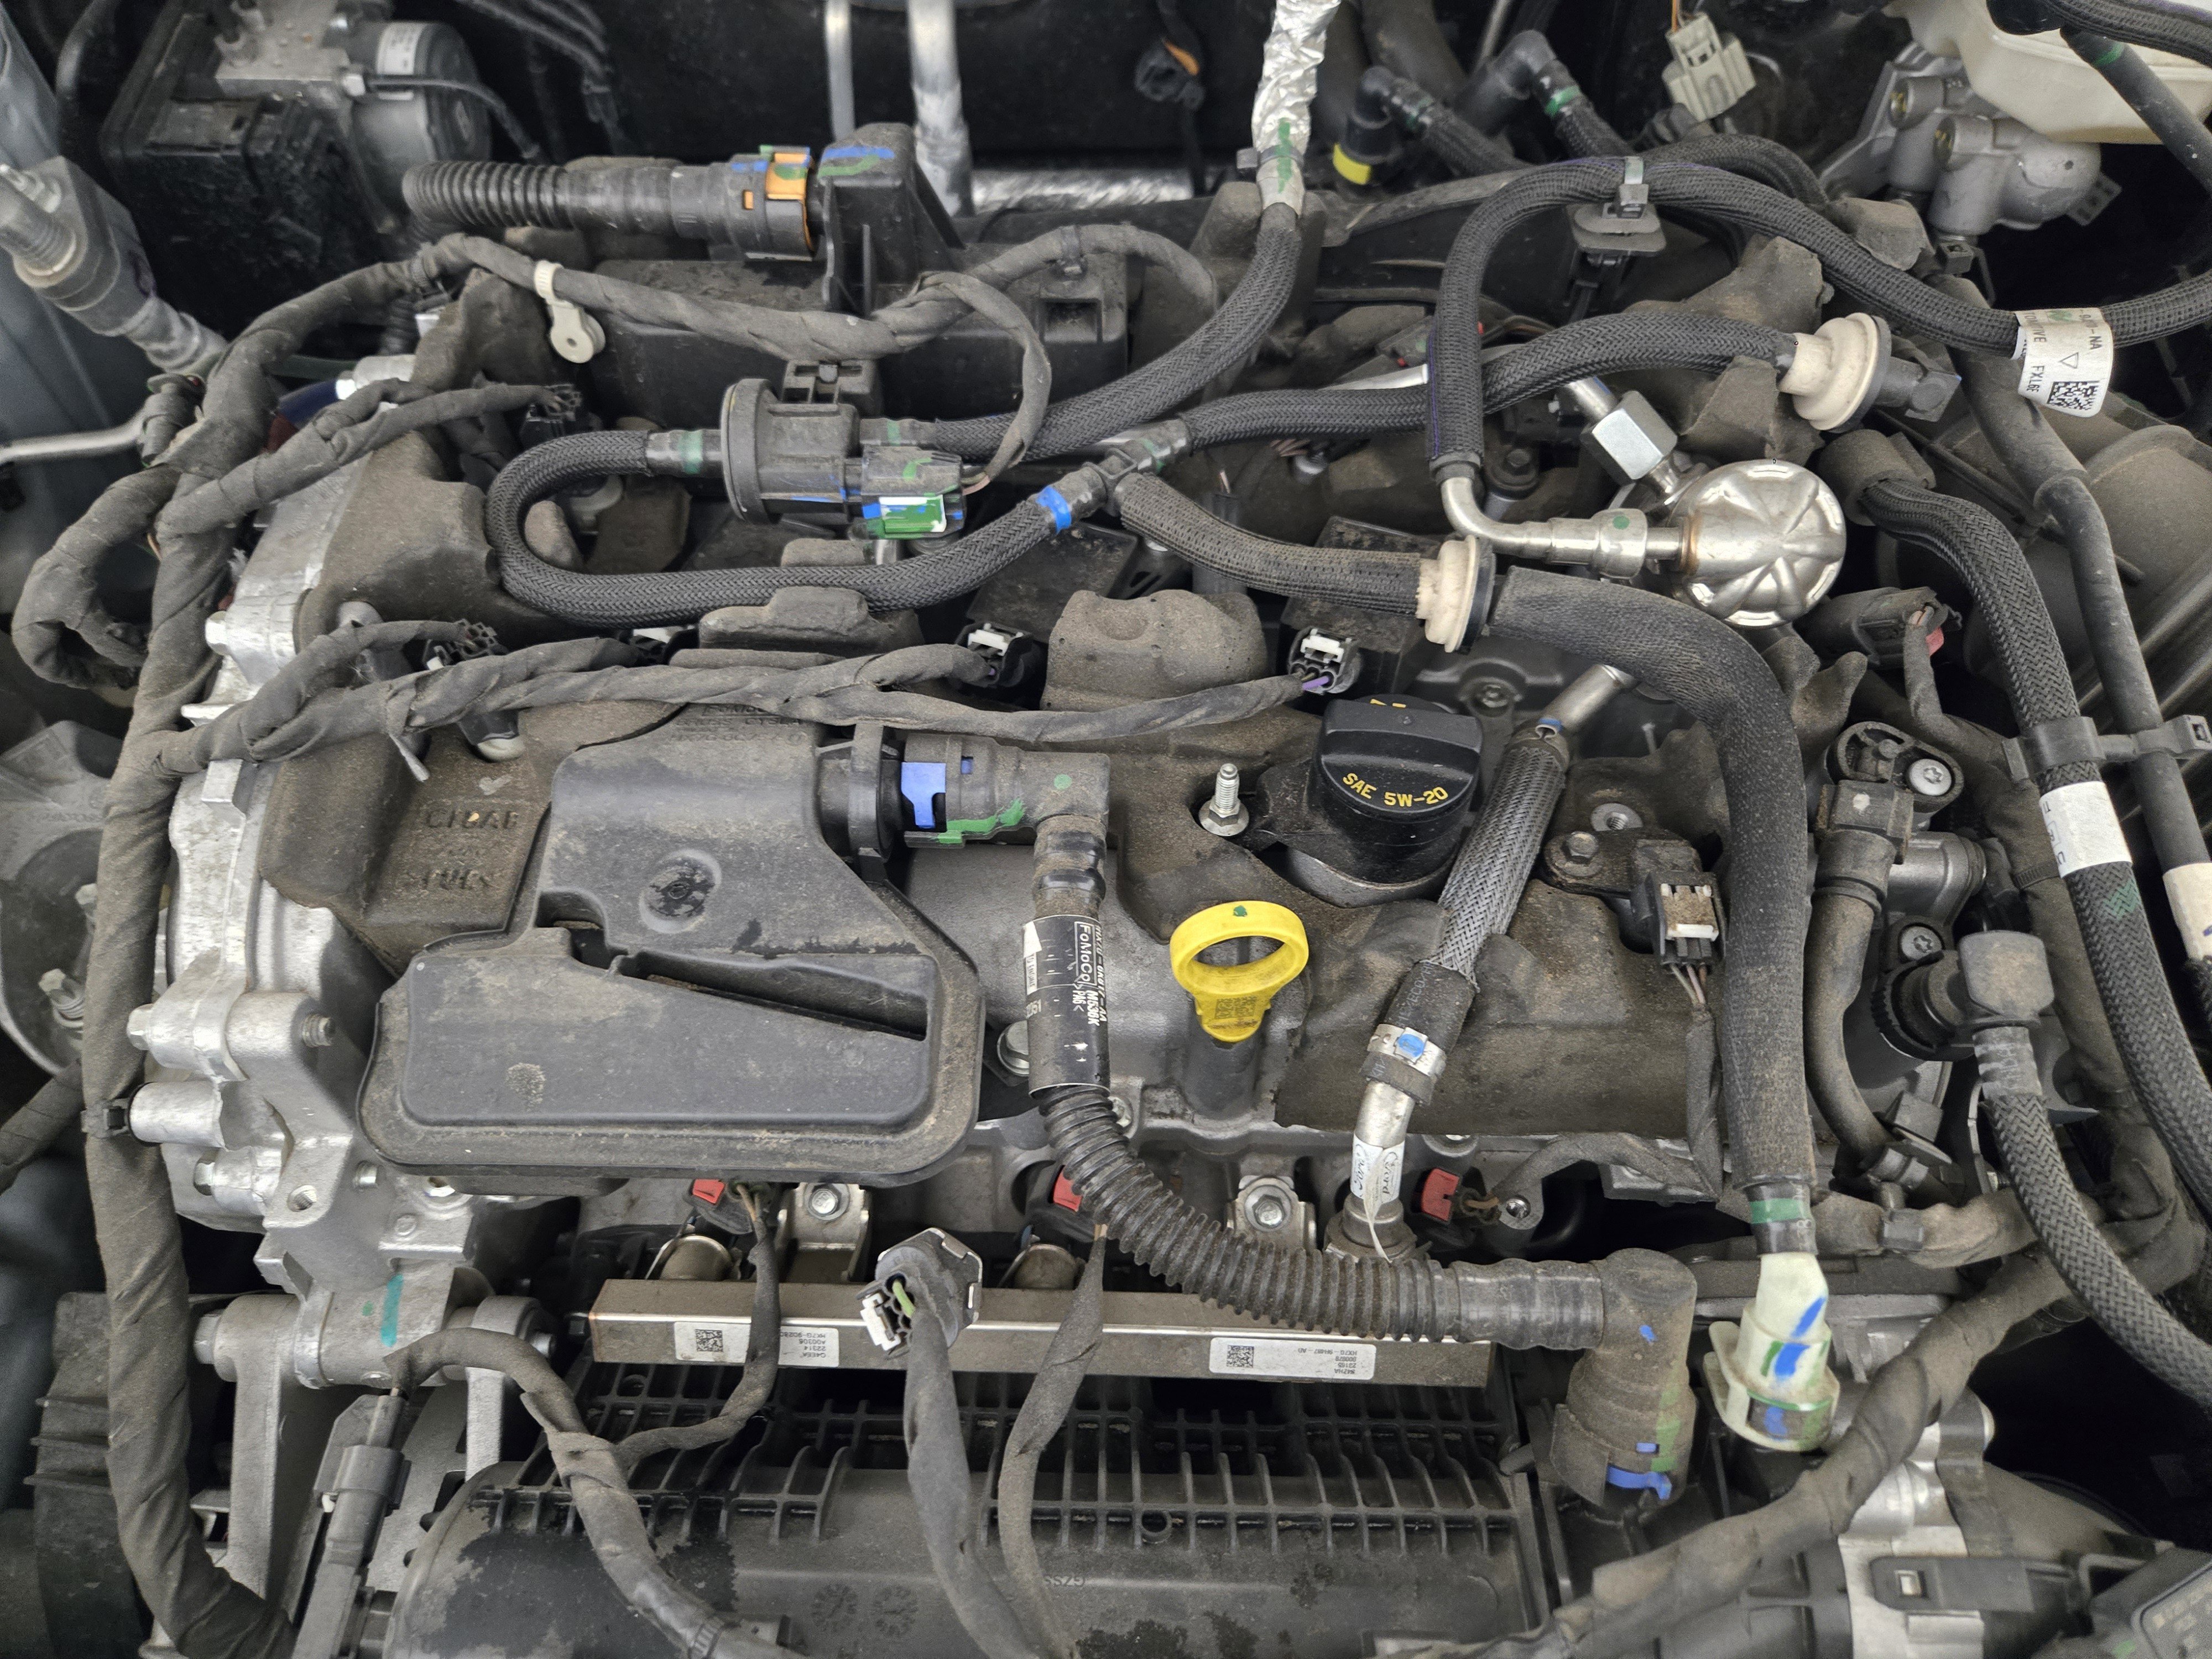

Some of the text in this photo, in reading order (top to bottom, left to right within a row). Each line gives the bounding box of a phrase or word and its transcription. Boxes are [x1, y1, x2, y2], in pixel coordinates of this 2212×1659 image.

[1342, 773, 1448, 807] SAE 5W-20
[1079, 924, 1091, 983] FoMoCo
